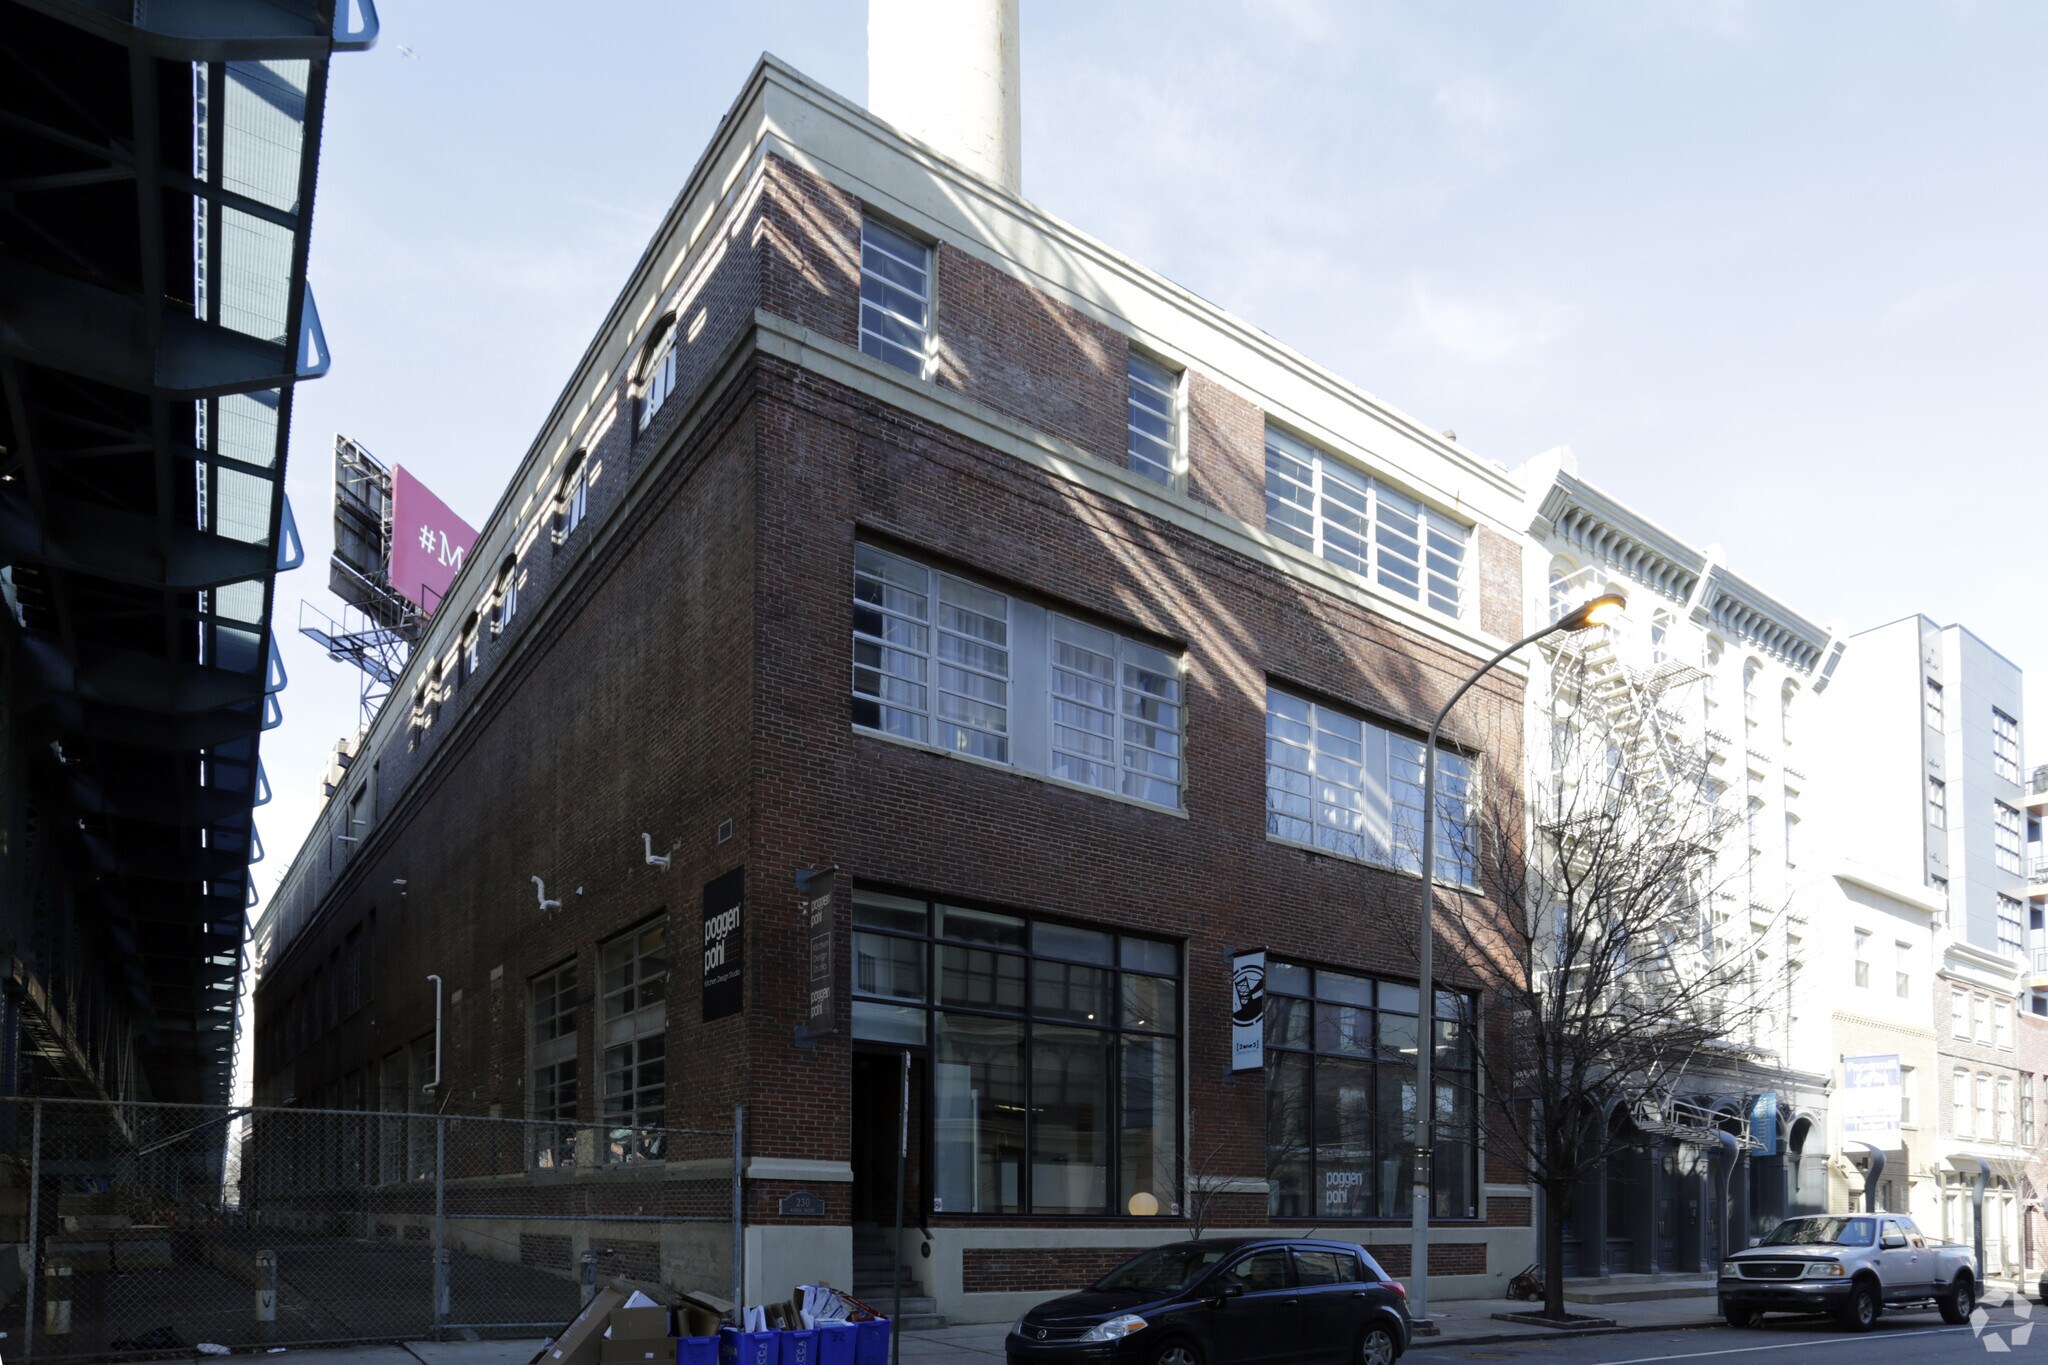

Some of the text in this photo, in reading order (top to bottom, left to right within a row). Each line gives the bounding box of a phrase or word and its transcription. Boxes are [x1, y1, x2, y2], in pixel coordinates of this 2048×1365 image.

[811, 894, 830, 913] poggen
[704, 905, 740, 946] poggen
[811, 910, 823, 929] pohl
[704, 939, 725, 976] pohl
[811, 987, 830, 1004] poggen
[811, 1002, 823, 1020] pohl
[1326, 1171, 1363, 1188] poggen
[795, 1197, 811, 1208] 230
[1326, 1188, 1348, 1206] pohl
